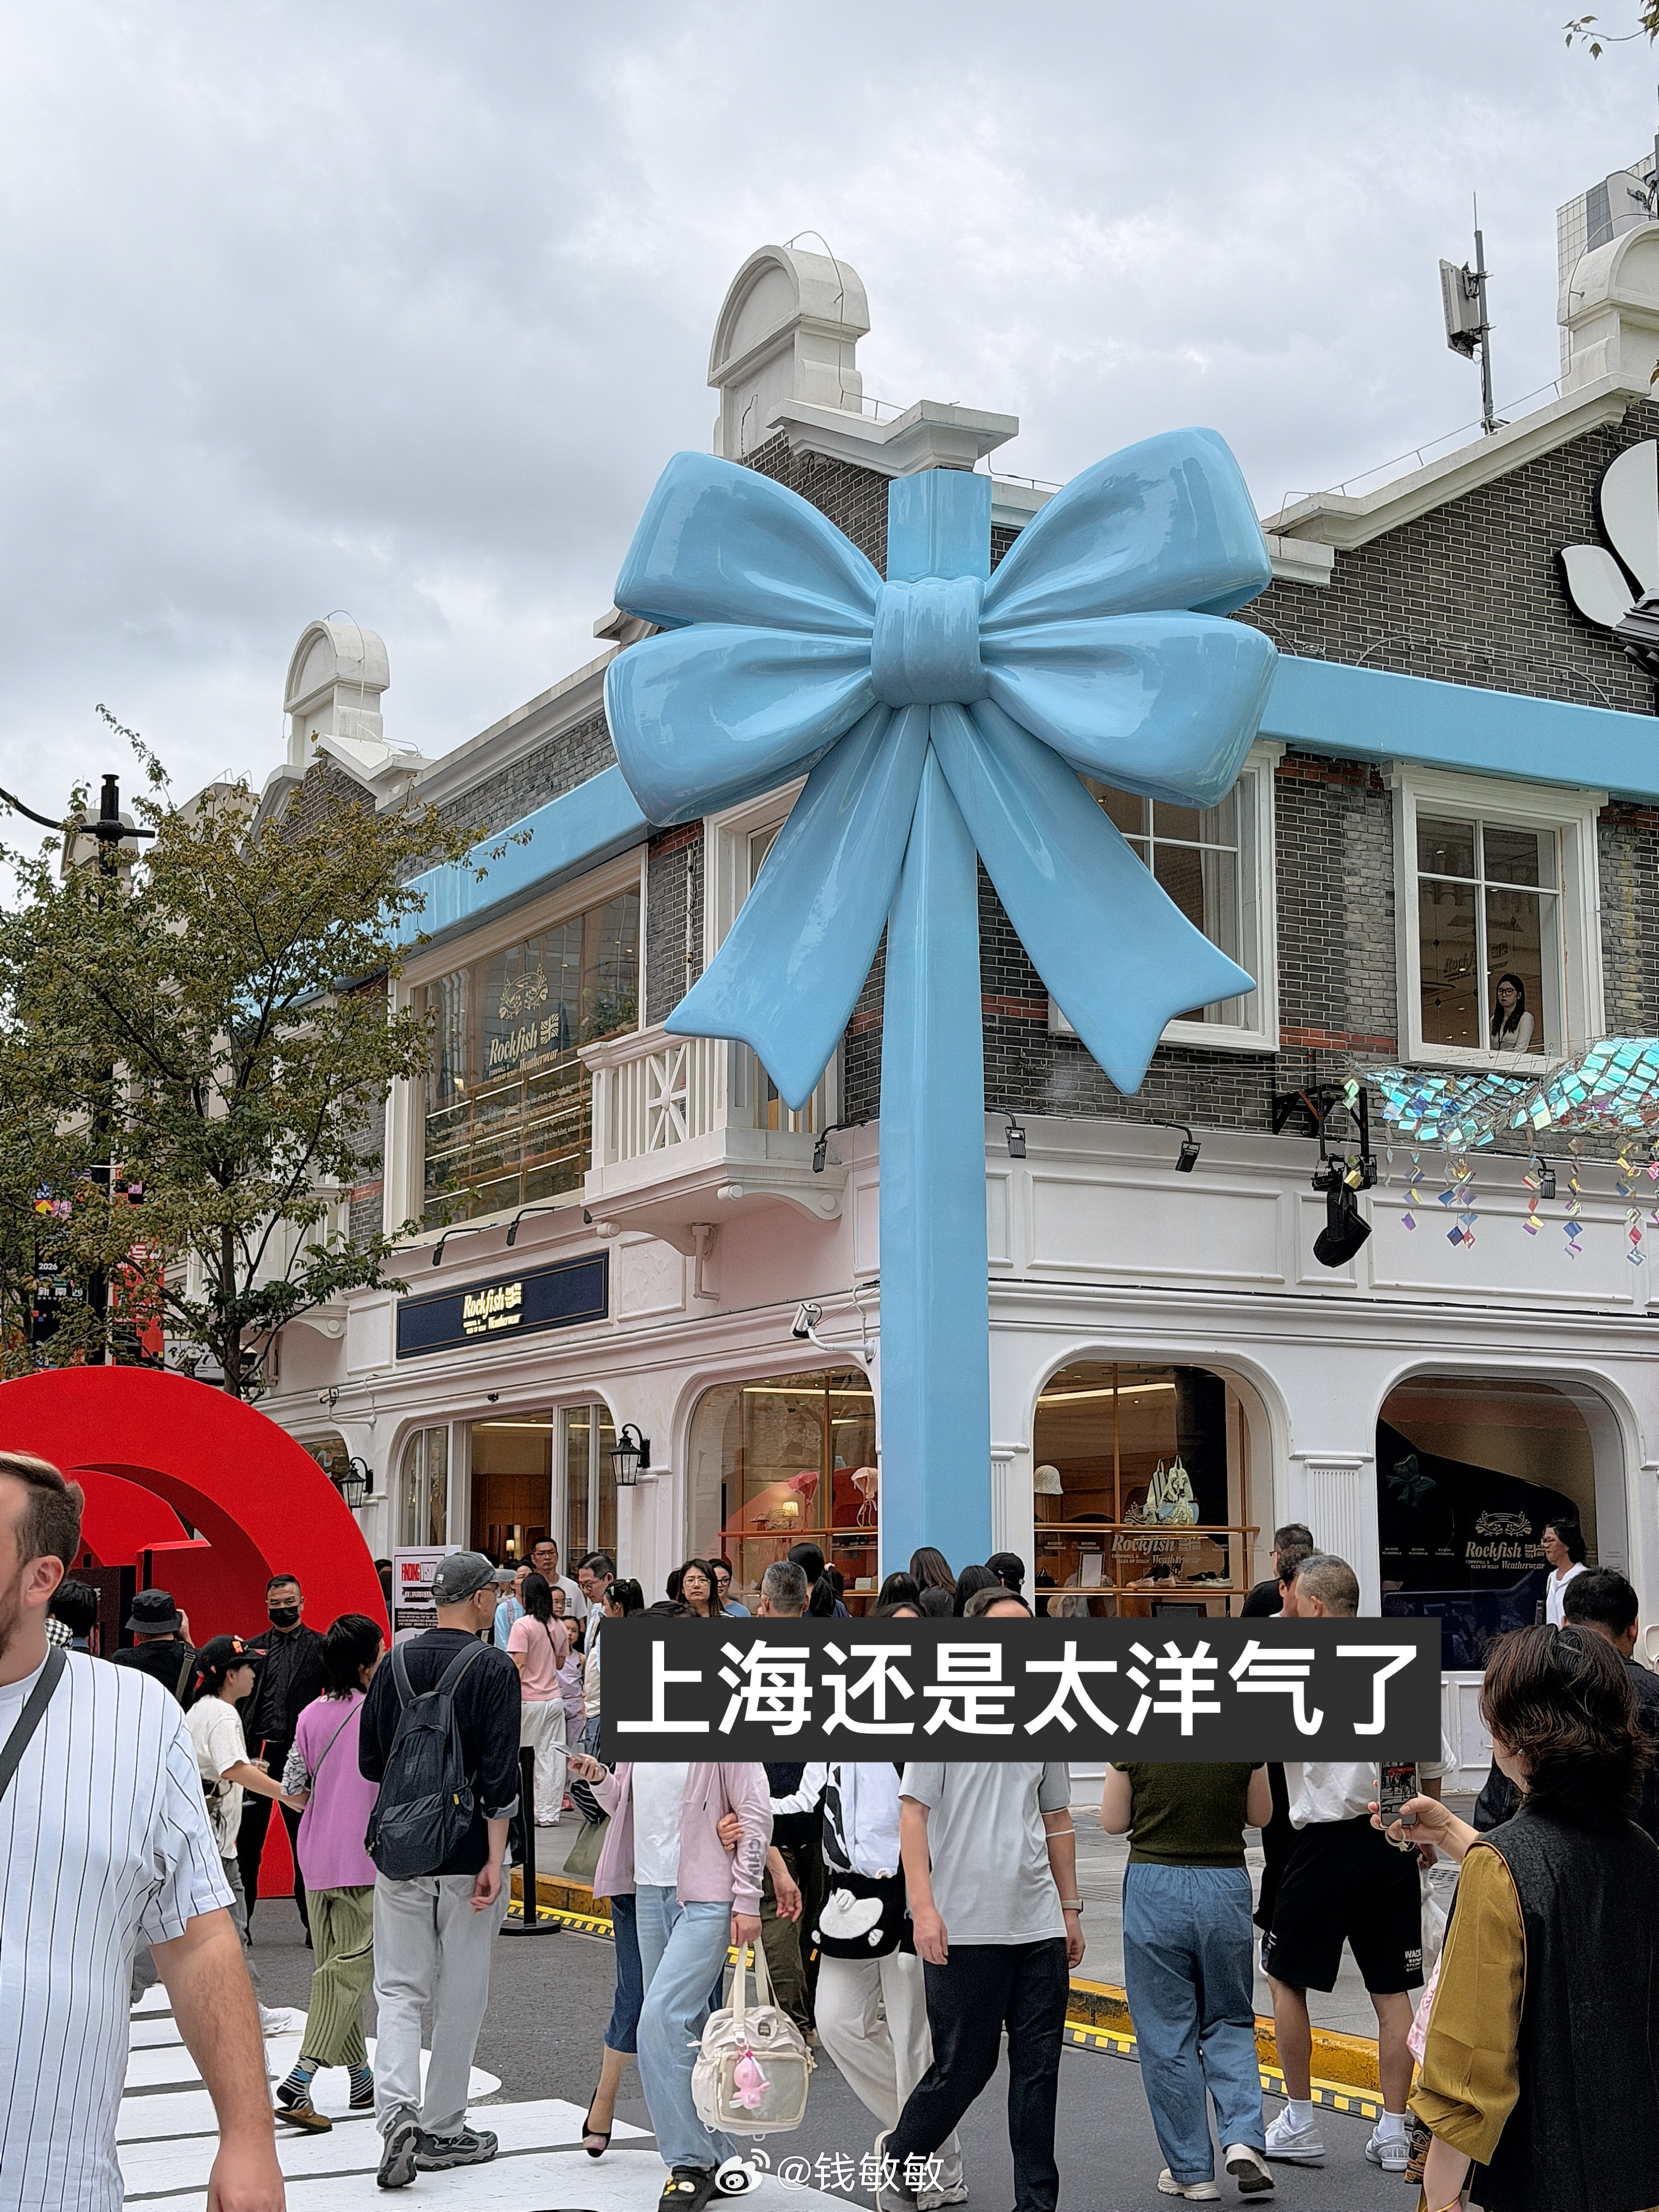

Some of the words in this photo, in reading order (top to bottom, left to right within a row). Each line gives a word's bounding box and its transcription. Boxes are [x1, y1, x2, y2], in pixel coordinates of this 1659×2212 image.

[488, 1022, 538, 1066] Rockfish
[520, 1048, 558, 1073] Weatherwear
[463, 1287, 504, 1320] Rockfish
[1111, 1535, 1176, 1556] Rockfish
[1465, 1542, 1521, 1561] Rockfish
[1152, 1554, 1201, 1564] Weather
[1502, 1561, 1545, 1569] Weatherwear
